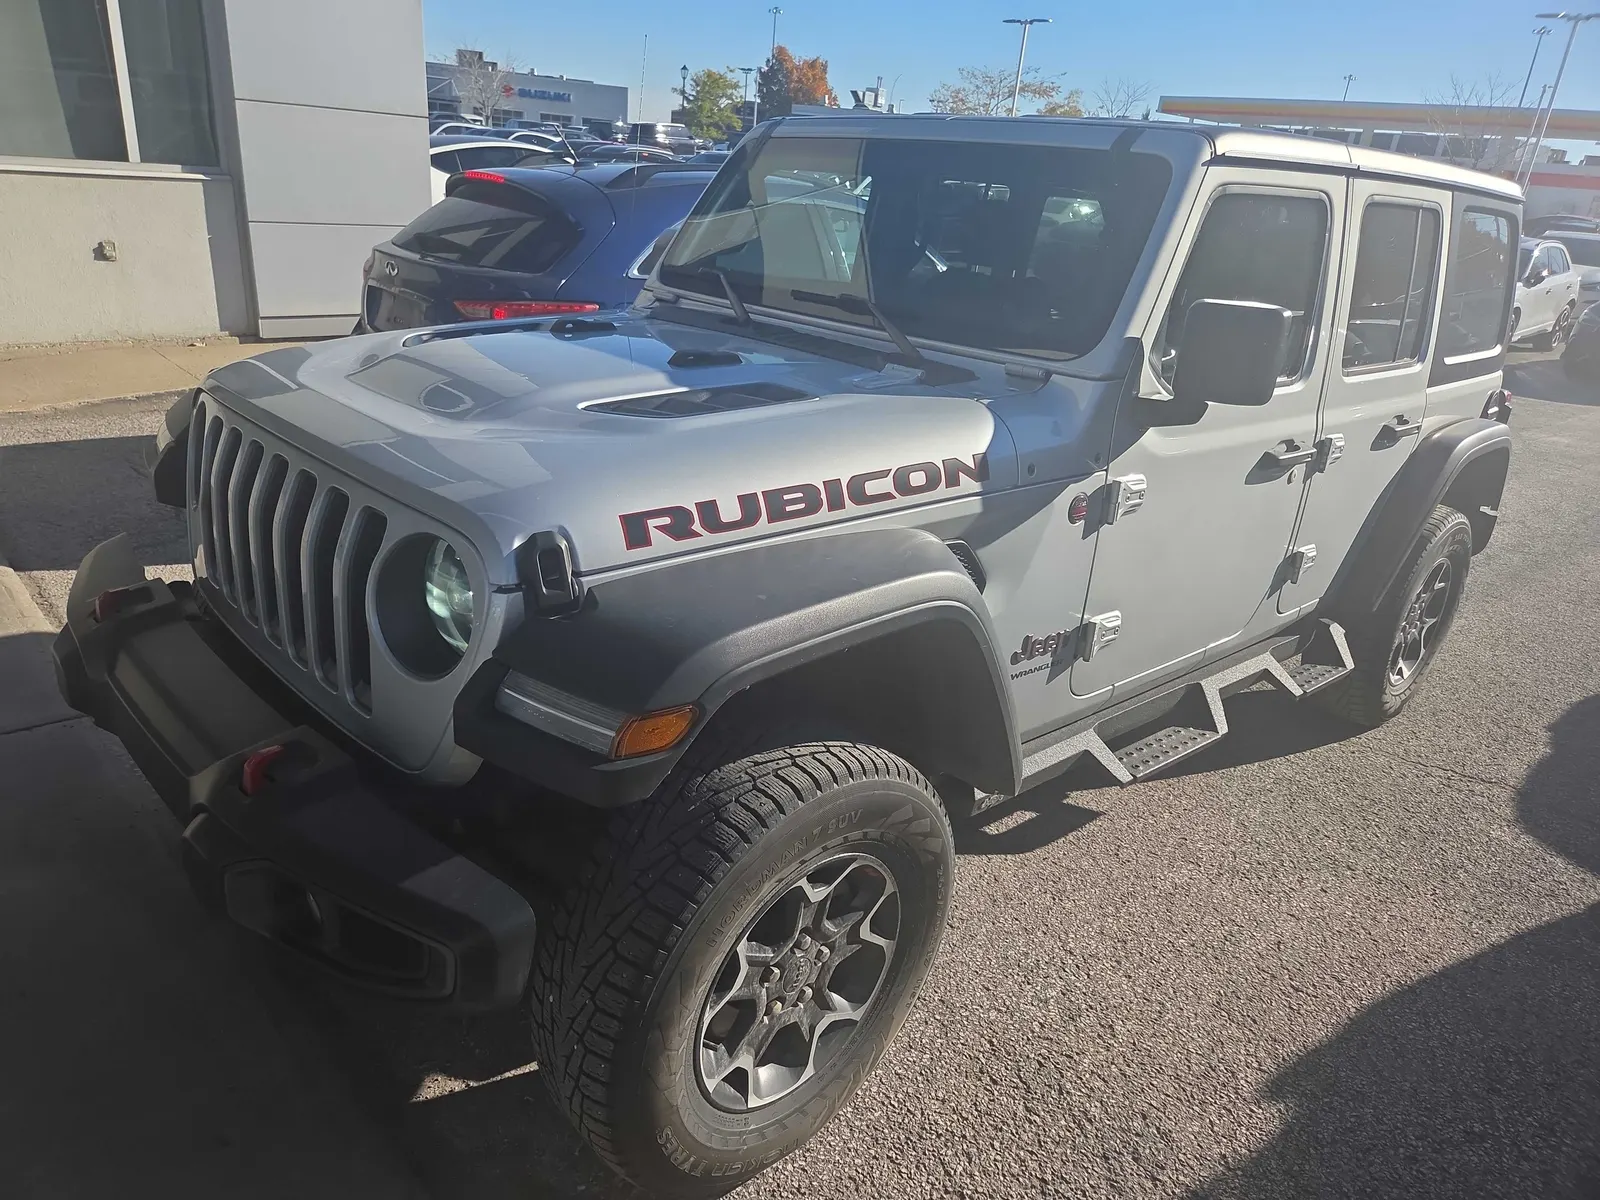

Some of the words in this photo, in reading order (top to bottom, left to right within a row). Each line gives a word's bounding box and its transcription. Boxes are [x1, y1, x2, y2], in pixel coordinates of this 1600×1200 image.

[518, 88, 572, 102] SUZUKI
[618, 453, 990, 551] RUBICON
[1010, 628, 1071, 665] Jeep
[827, 808, 864, 835] SUV
[657, 1126, 708, 1177] TYRES
